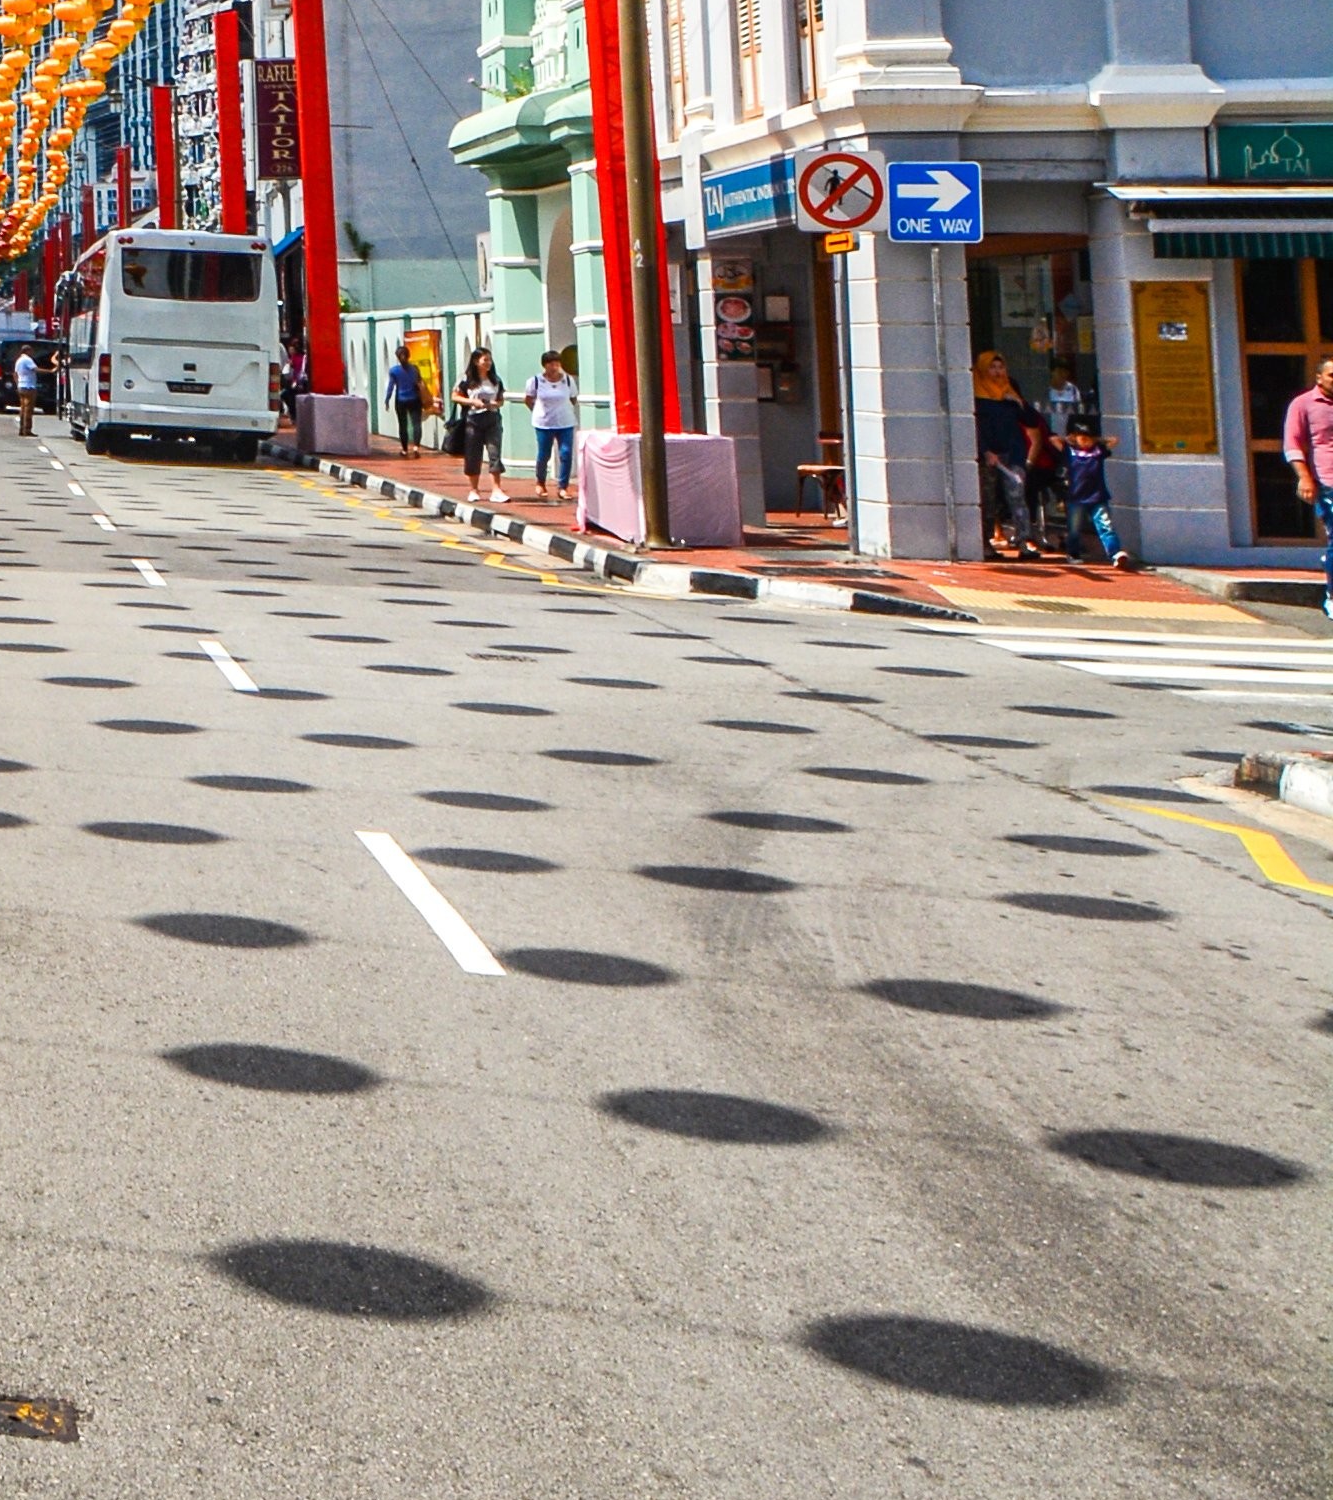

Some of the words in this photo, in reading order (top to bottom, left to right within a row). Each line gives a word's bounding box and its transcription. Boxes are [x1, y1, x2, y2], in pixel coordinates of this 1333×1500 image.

[269, 91, 295, 160] TAILOR
[897, 217, 932, 234] ONE
[939, 218, 973, 234] WAY
